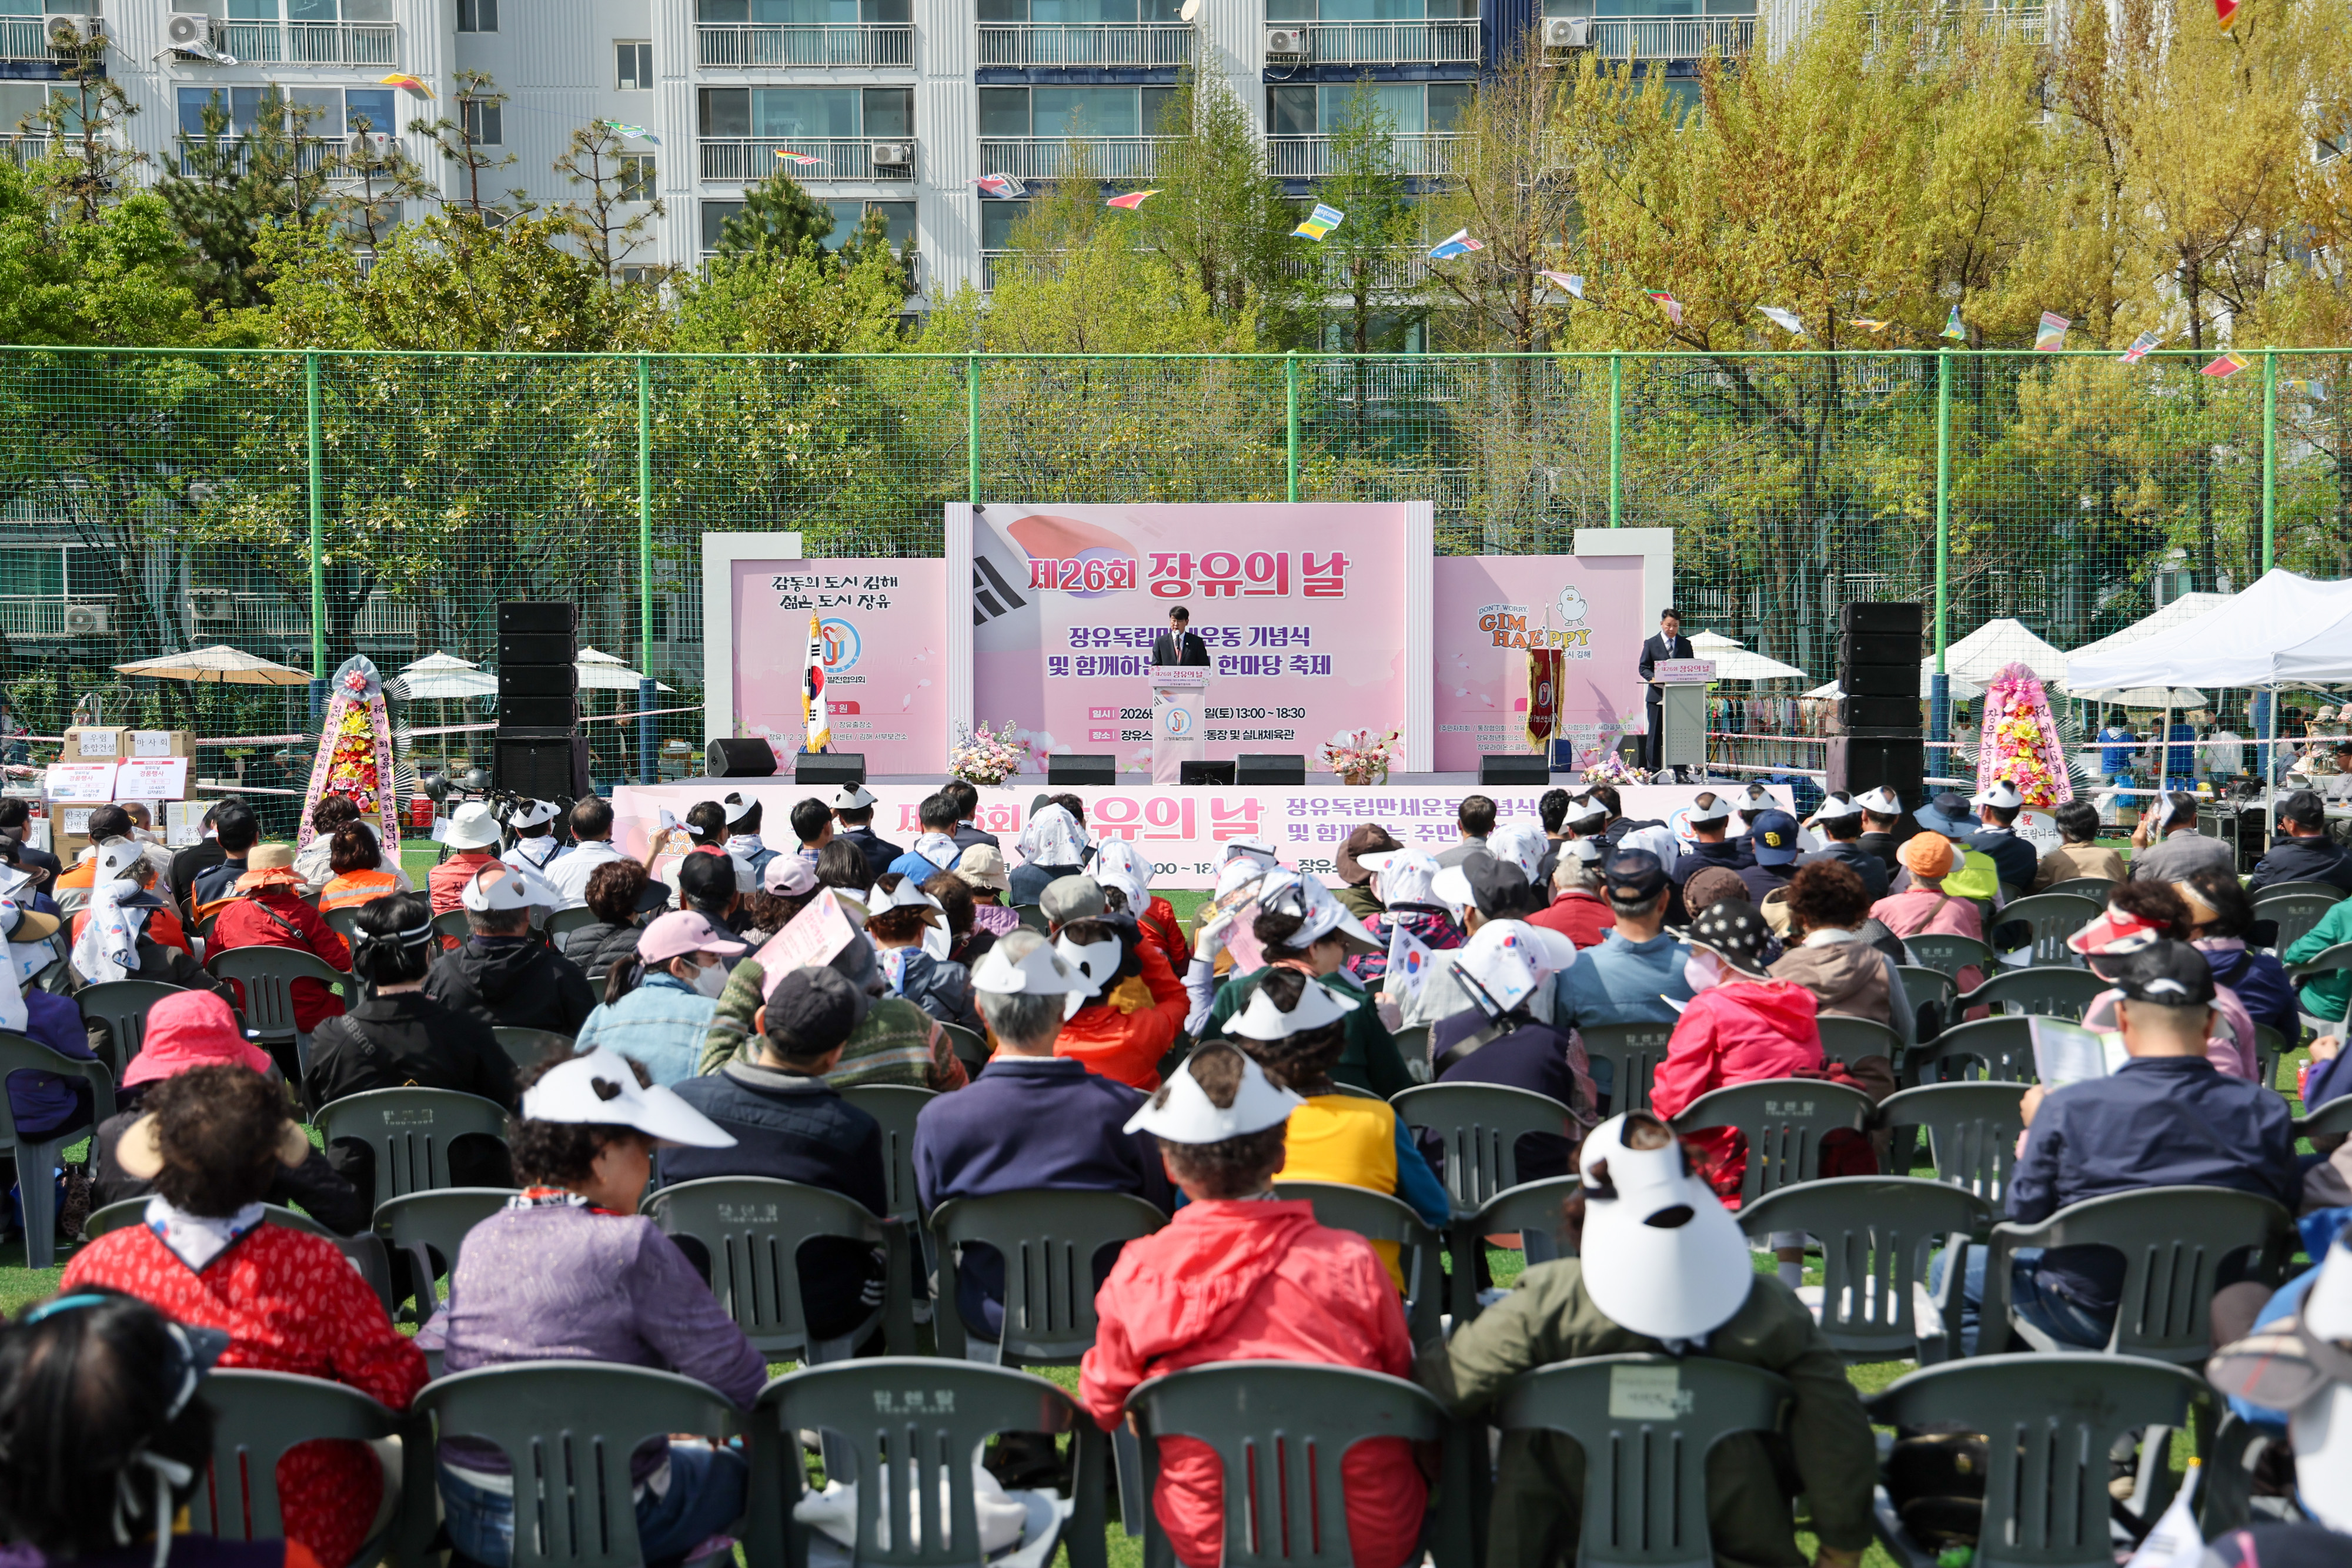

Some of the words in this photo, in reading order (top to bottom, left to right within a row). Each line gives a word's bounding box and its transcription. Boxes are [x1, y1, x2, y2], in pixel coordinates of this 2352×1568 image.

[1028, 559, 1136, 590] 제26회
[1148, 551, 1289, 598] 장유의
[1302, 551, 1351, 598] 날
[771, 576, 819, 592] 감동의
[824, 576, 858, 589] 도시
[863, 576, 898, 590] 김해
[780, 594, 813, 610] 젊은
[818, 594, 851, 607] 도시
[857, 594, 891, 610] 장유
[1479, 605, 1500, 614] DON'T
[1479, 613, 1527, 632] GIM
[1068, 627, 1241, 647] 장유독립운동
[1248, 627, 1311, 647] 기념식
[1576, 650, 1591, 658] 김해
[1048, 656, 1069, 676] 및
[1218, 656, 1282, 676] 한마당
[1289, 656, 1331, 676] 축제
[825, 676, 866, 684] 발전협의회
[373, 704, 386, 714] 祝
[1092, 710, 1110, 718] 일시
[1236, 708, 1265, 718] 13:00
[1277, 708, 1305, 718] 18:30
[2035, 704, 2049, 718] 祝
[1092, 731, 1110, 740] 장소
[1230, 730, 1240, 740] 및
[1242, 729, 1295, 740] 실내체육관
[1439, 724, 1470, 733] (주민자치회
[90, 734, 107, 742] 우림
[82, 744, 115, 753] 종합건설
[1286, 798, 1461, 817] 장유독립만세운동
[1494, 798, 1536, 817] 념식
[66, 811, 92, 820] 한국지
[896, 804, 1021, 833] 제6회
[1210, 797, 1265, 841] 날
[1288, 824, 1309, 842] 및
[1414, 824, 1458, 842] 주민
